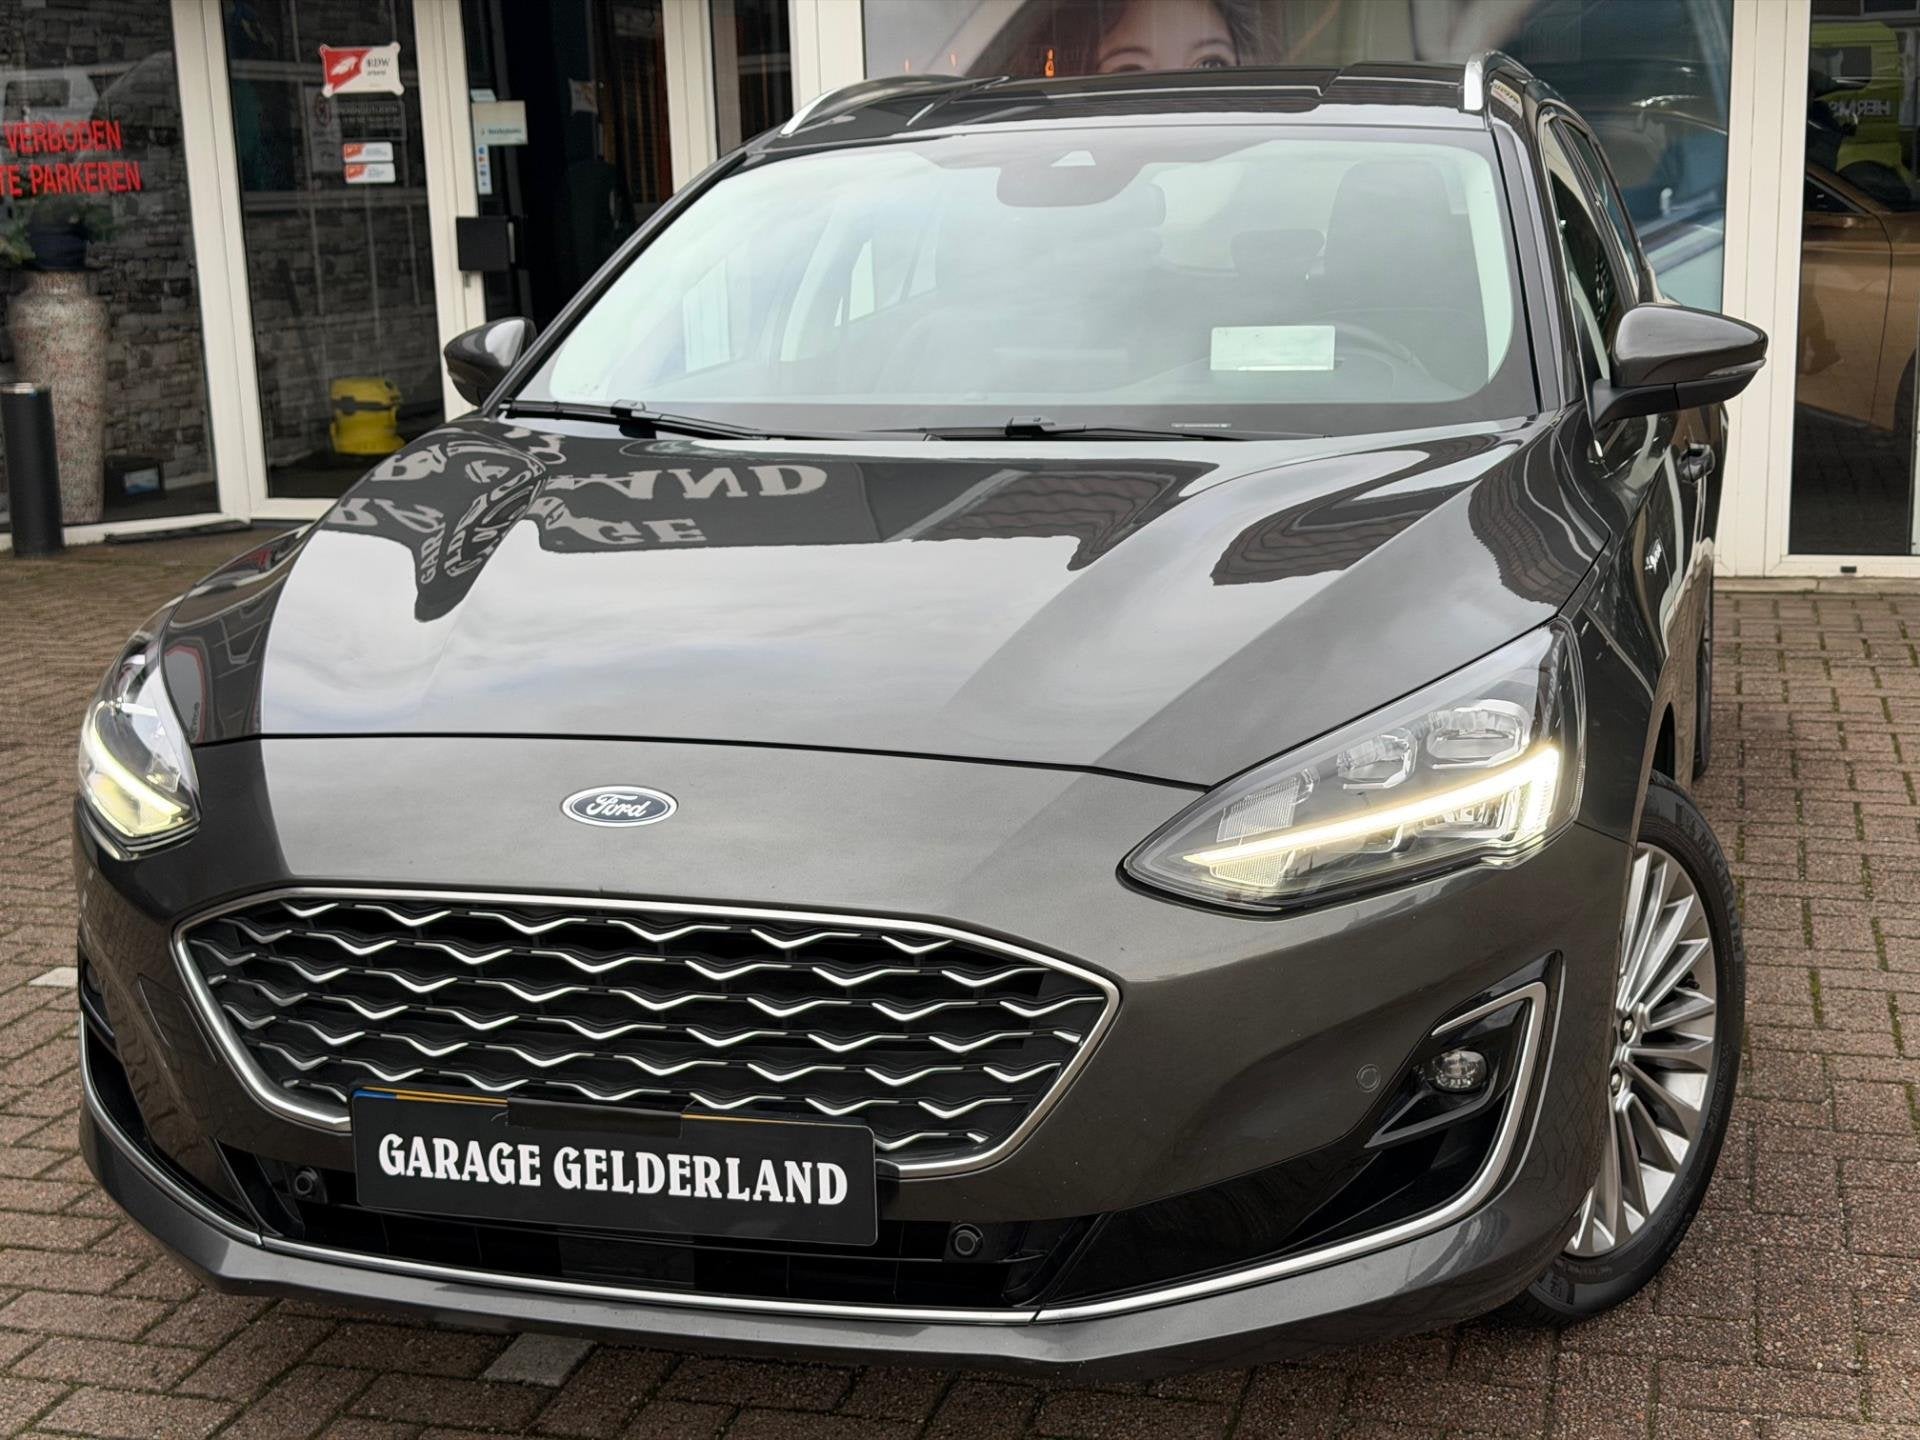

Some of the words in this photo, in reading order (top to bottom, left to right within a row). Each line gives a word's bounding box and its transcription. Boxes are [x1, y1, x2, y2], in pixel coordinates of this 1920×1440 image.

[4, 120, 123, 153] VERBODEN
[30, 160, 142, 195] PARKEREN
[586, 793, 652, 817] Ford
[378, 1133, 541, 1186] GARAGE
[553, 1146, 849, 1206] GELDERLAND
